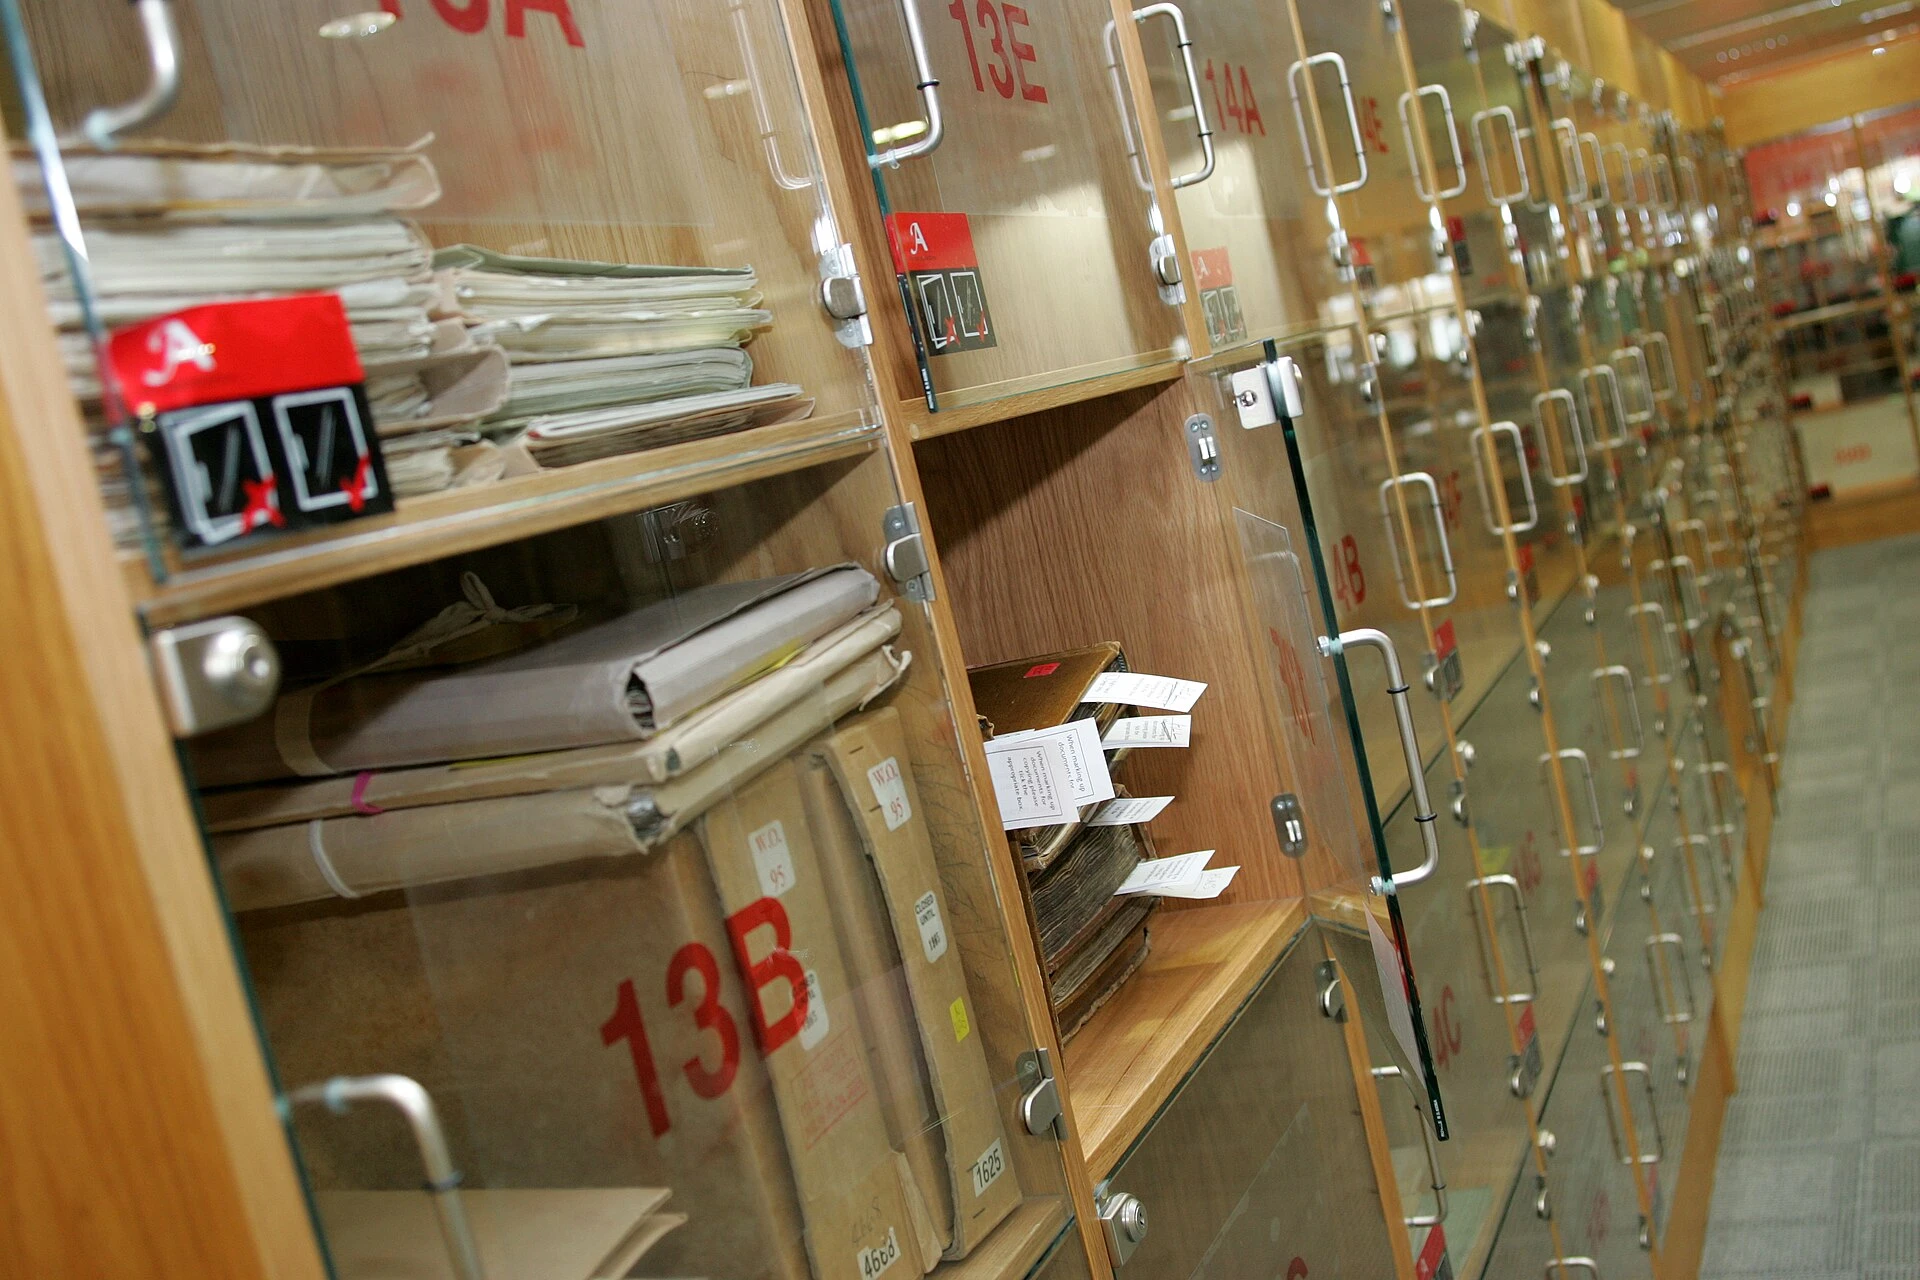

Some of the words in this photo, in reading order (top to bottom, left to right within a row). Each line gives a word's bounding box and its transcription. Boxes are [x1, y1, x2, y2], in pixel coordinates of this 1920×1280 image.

[948, 0, 1048, 104] 13E
[1205, 58, 1267, 137] 14A
[909, 222, 929, 255] A
[143, 318, 217, 387] A
[1007, 756, 1020, 797] appropriate
[1018, 769, 1026, 783] tick
[1023, 757, 1033, 785] copying
[1030, 785, 1039, 807] please
[1031, 756, 1043, 794] documents
[1036, 751, 1045, 770] When
[1042, 770, 1053, 802] marking
[1050, 802, 1056, 811] up
[1066, 734, 1076, 754] When
[1072, 754, 1083, 783] marking
[1079, 783, 1086, 792] up
[890, 797, 904, 823] 95
[769, 863, 786, 893] 95
[915, 894, 934, 915] CLOSED
[601, 896, 809, 1140] 13B
[976, 1148, 1002, 1188] 1625
